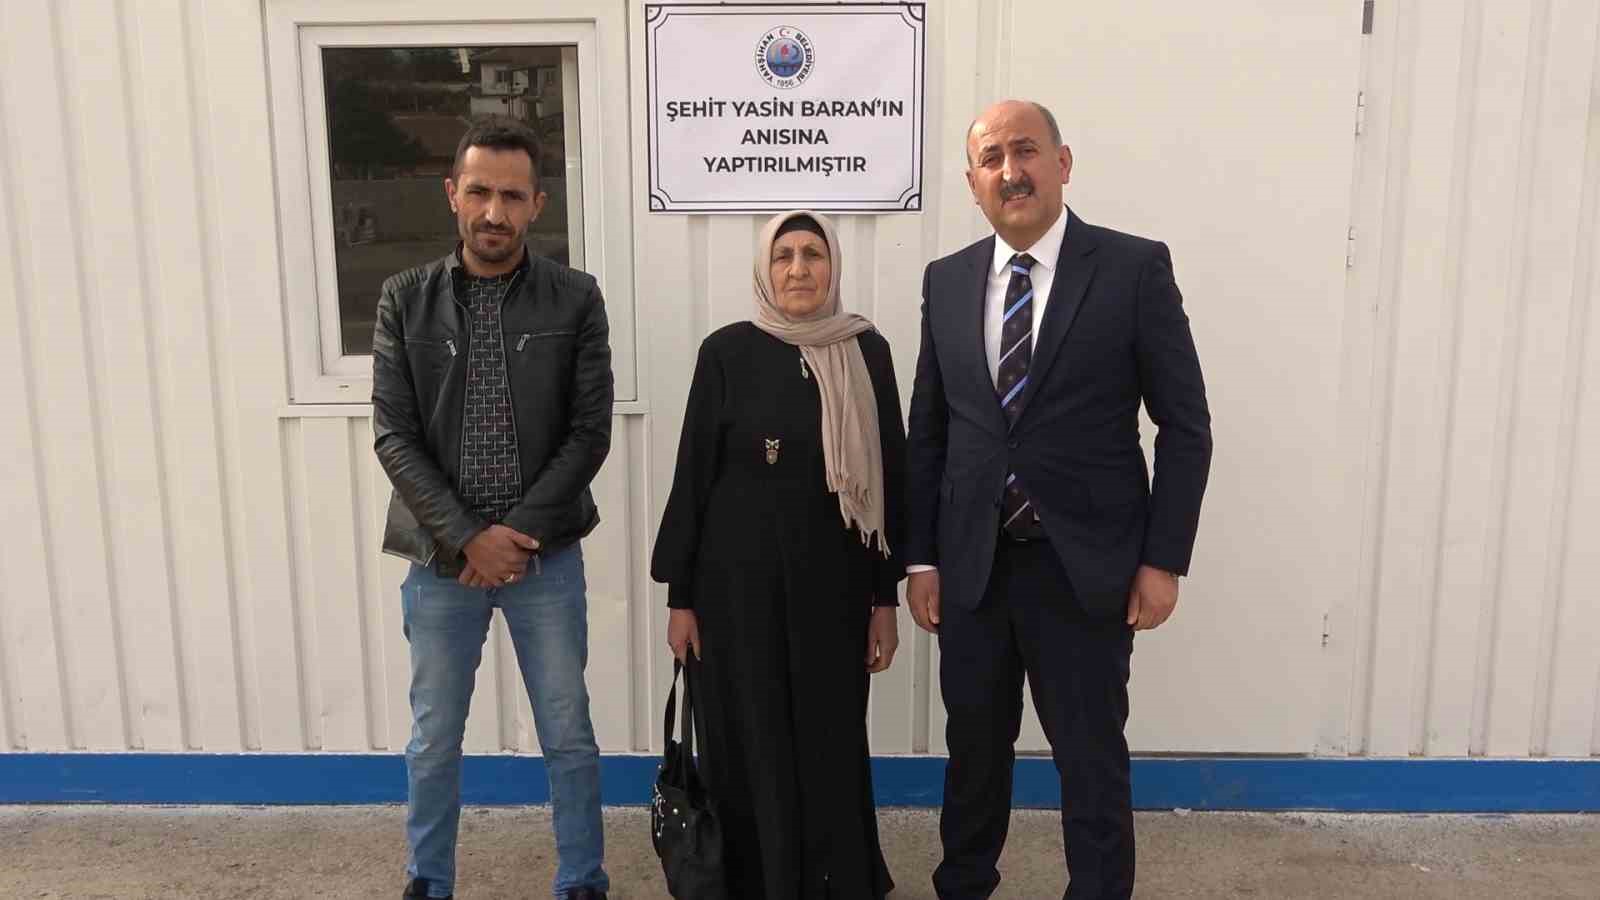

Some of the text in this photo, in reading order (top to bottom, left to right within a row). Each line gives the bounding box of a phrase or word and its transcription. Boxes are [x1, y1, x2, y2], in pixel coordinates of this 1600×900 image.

[666, 97, 903, 121] ŞEHİT YASİN BARAN'IN
[740, 129, 829, 145] ANISINA
[703, 156, 867, 176] YAPTIRILMIŞTIR
